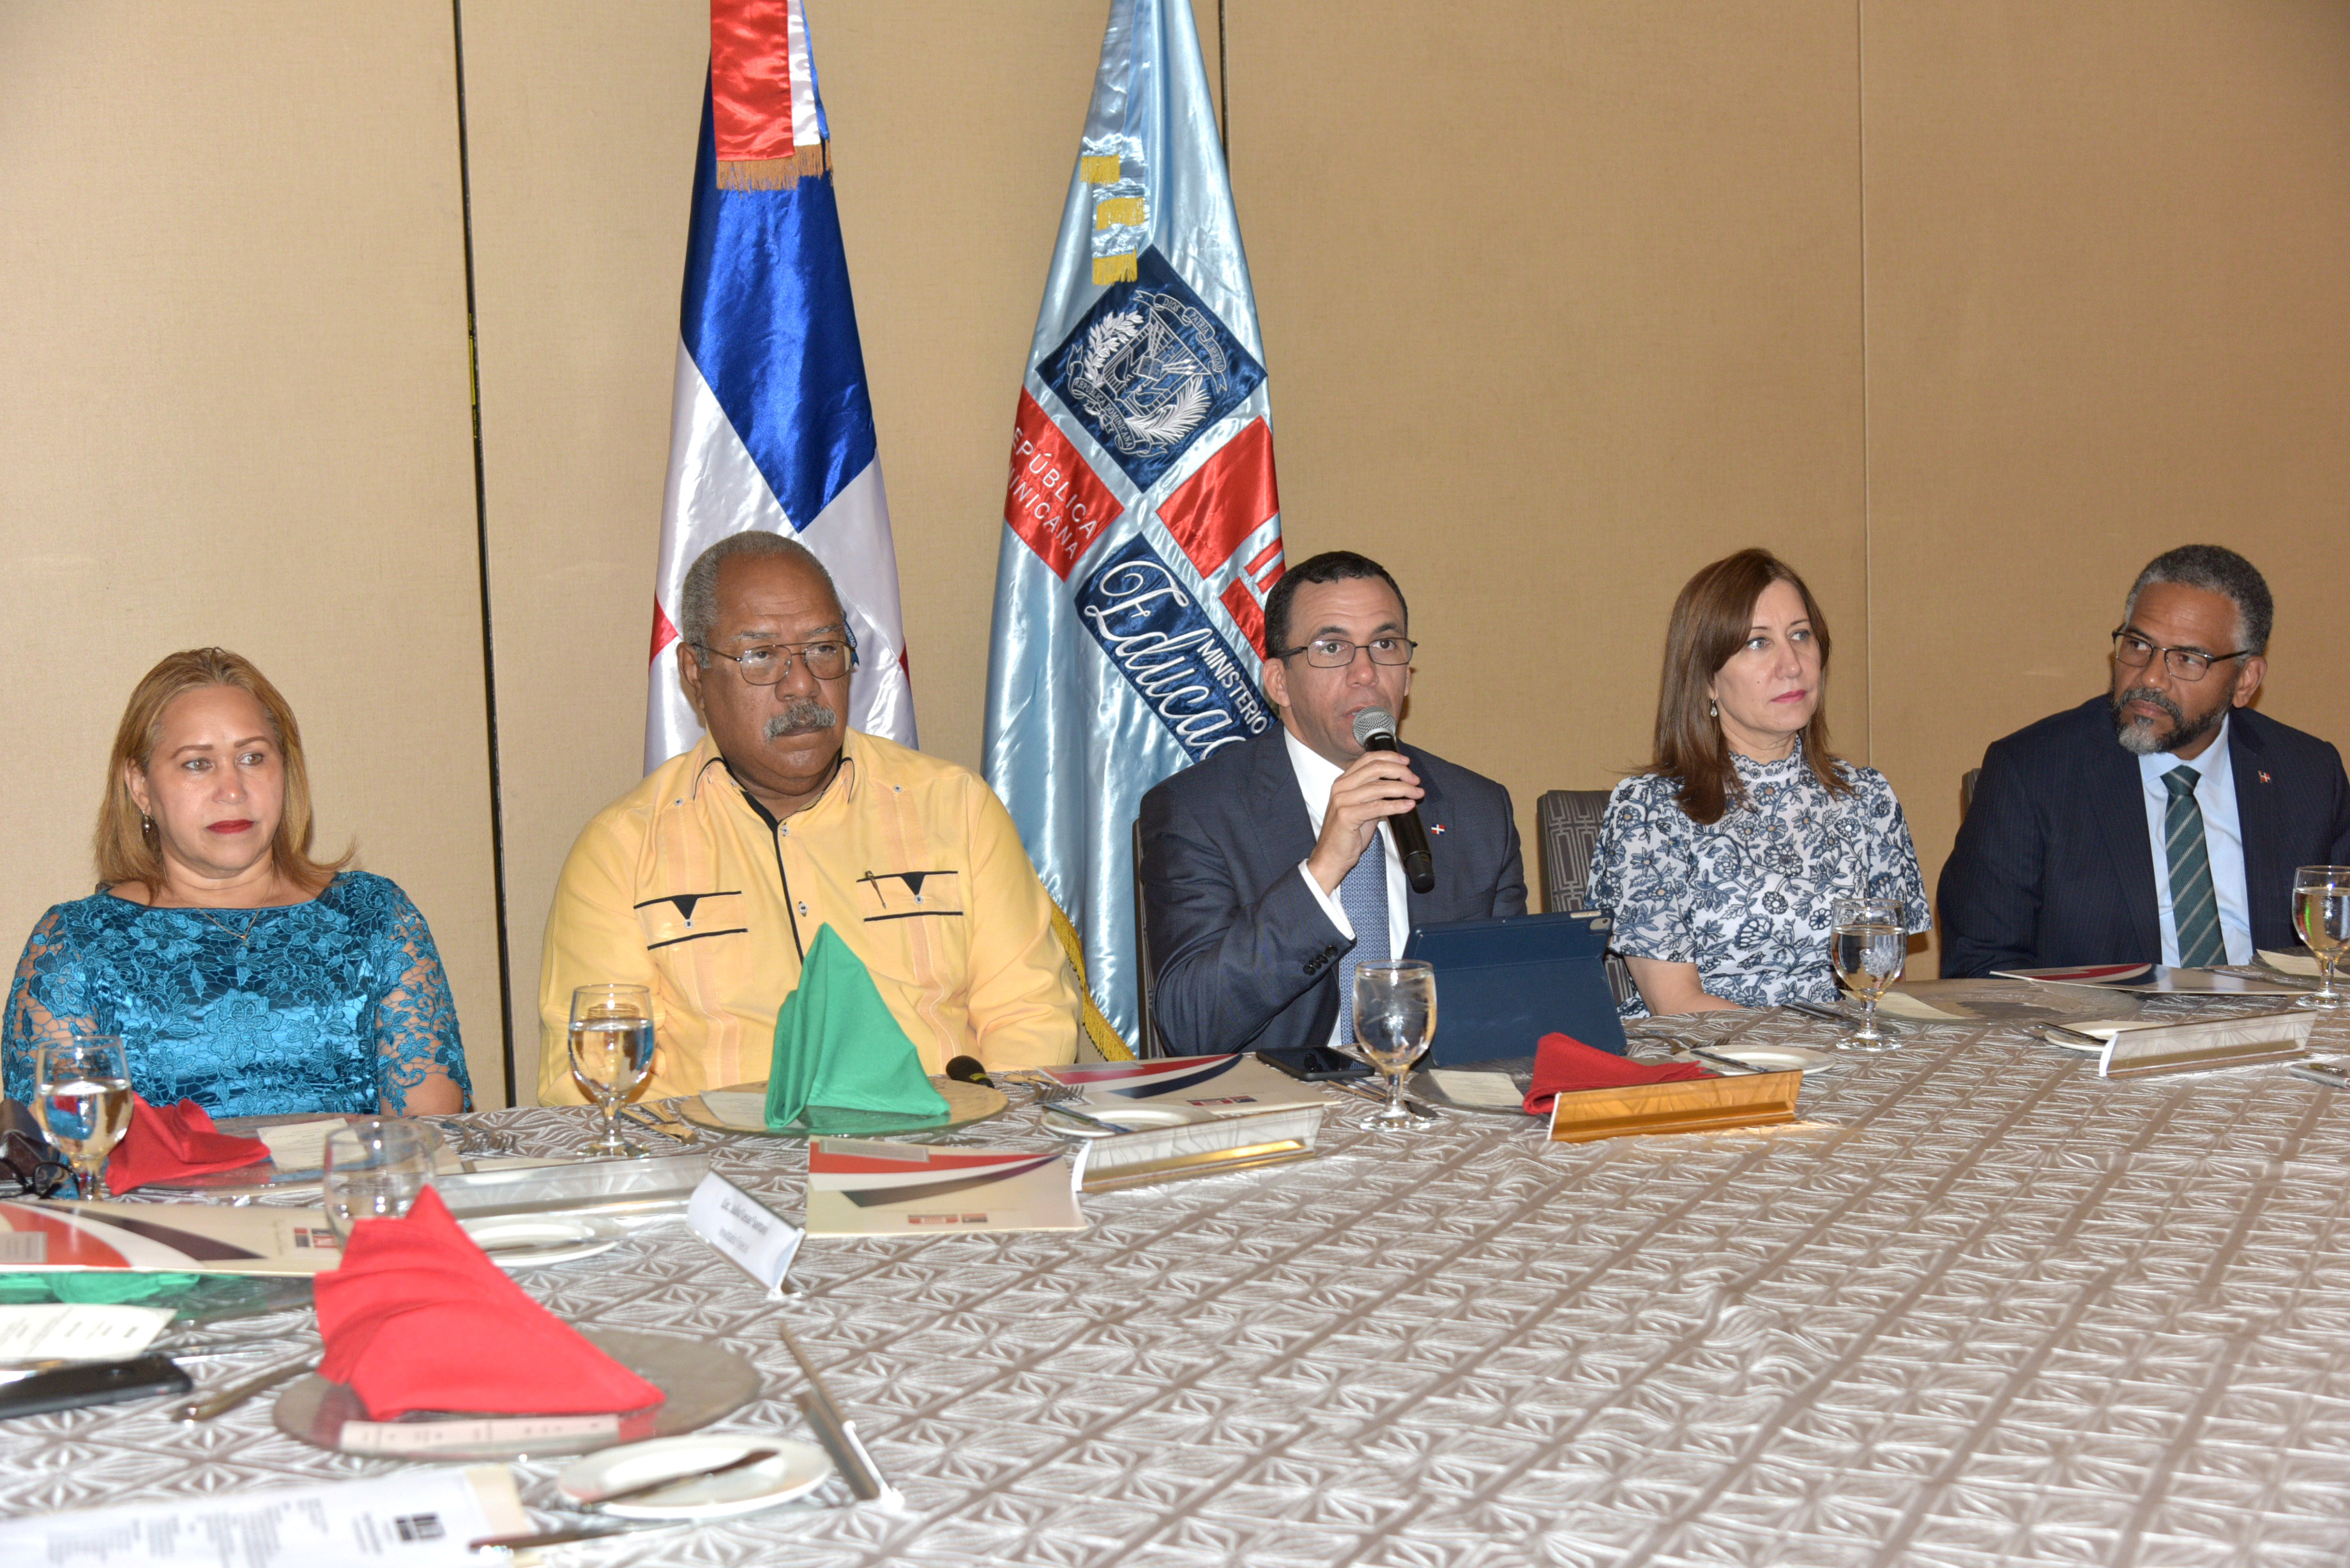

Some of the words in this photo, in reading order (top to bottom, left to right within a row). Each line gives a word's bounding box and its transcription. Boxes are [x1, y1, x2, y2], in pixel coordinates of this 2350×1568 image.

[1163, 298, 1180, 312] DIOS
[1190, 311, 1209, 335] PATRIA
[1009, 461, 1078, 559] INICANA
[1012, 427, 1096, 539] EPÚBLICA
[1197, 638, 1268, 734] MINISTERIO
